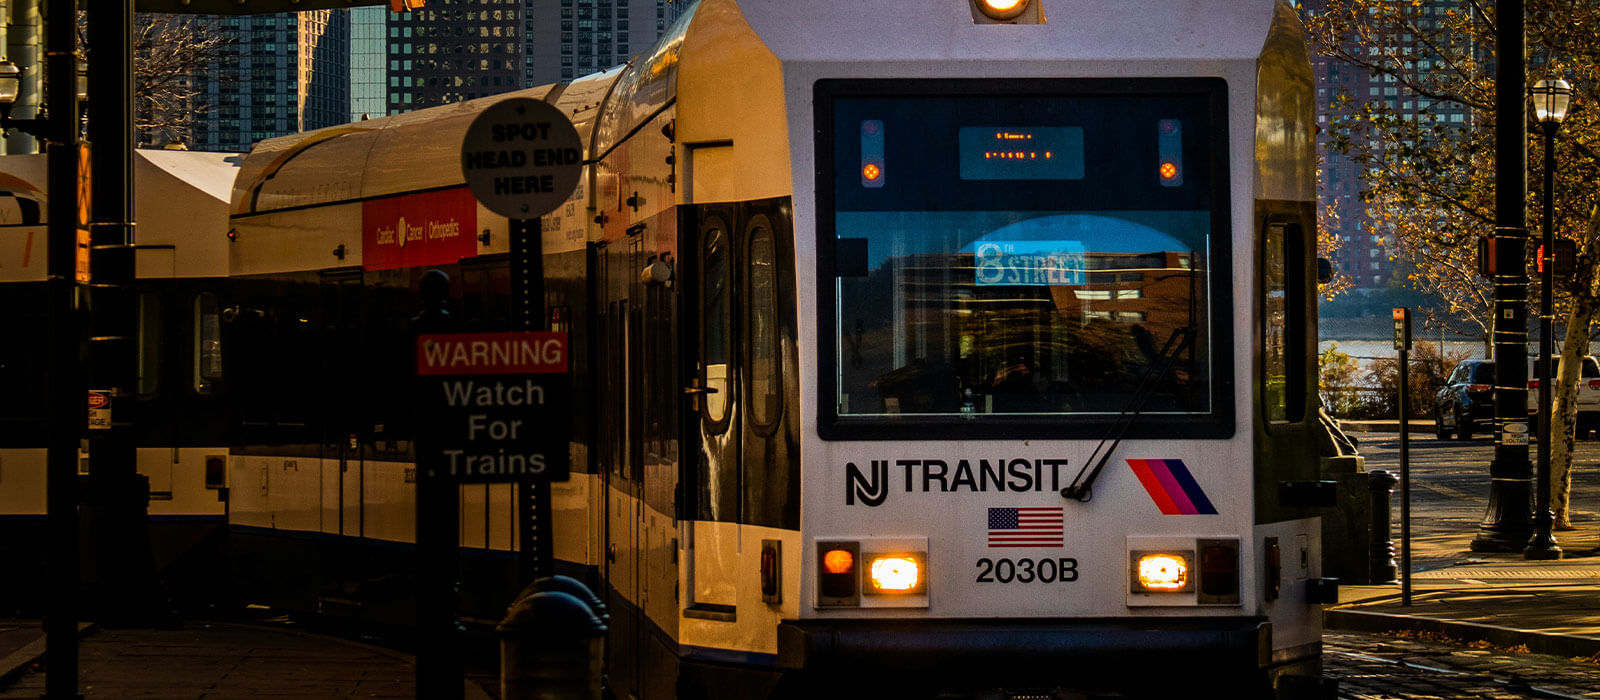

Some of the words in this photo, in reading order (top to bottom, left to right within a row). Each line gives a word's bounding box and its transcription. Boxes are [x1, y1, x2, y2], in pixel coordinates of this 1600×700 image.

[492, 122, 551, 143] SPOT
[466, 149, 526, 170] HEAD
[533, 147, 579, 168] END
[494, 175, 553, 195] HERE
[407, 223, 424, 242] Cancer
[1008, 255, 1083, 284] STREET
[423, 340, 562, 368] WARNING
[442, 379, 546, 408] Watch
[467, 413, 524, 442] For
[443, 447, 548, 476] Trains
[846, 460, 889, 507] NJ
[896, 459, 1067, 492] TRANSIT
[976, 558, 1079, 584] 2030B
